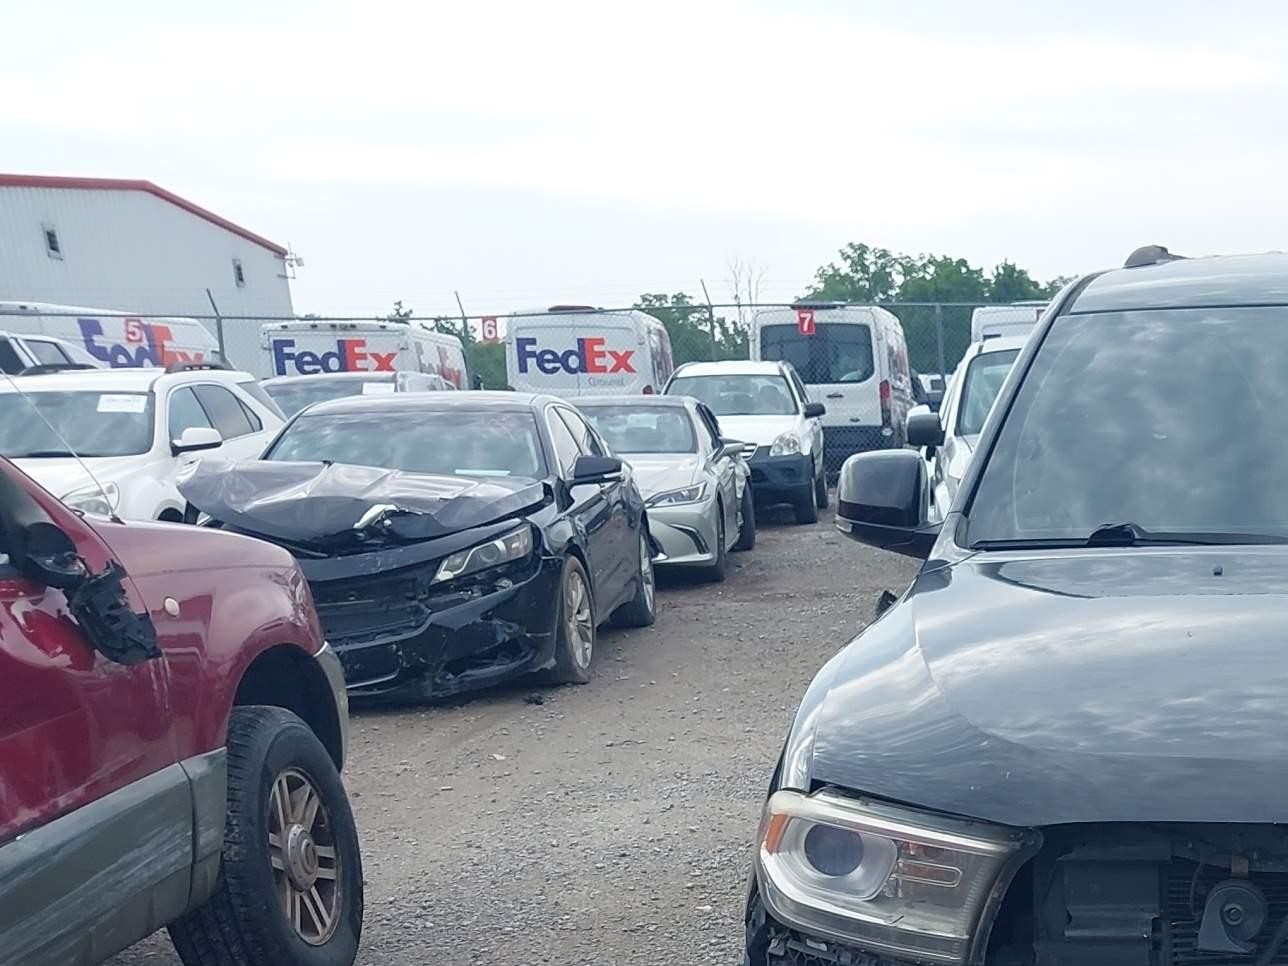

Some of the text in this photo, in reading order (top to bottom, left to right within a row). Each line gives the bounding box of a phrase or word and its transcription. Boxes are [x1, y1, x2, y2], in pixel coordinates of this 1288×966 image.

[127, 322, 142, 341] 5
[483, 319, 496, 339] 6
[799, 312, 811, 332] 7
[273, 338, 398, 375] FedEx
[516, 337, 637, 374] FedEx
